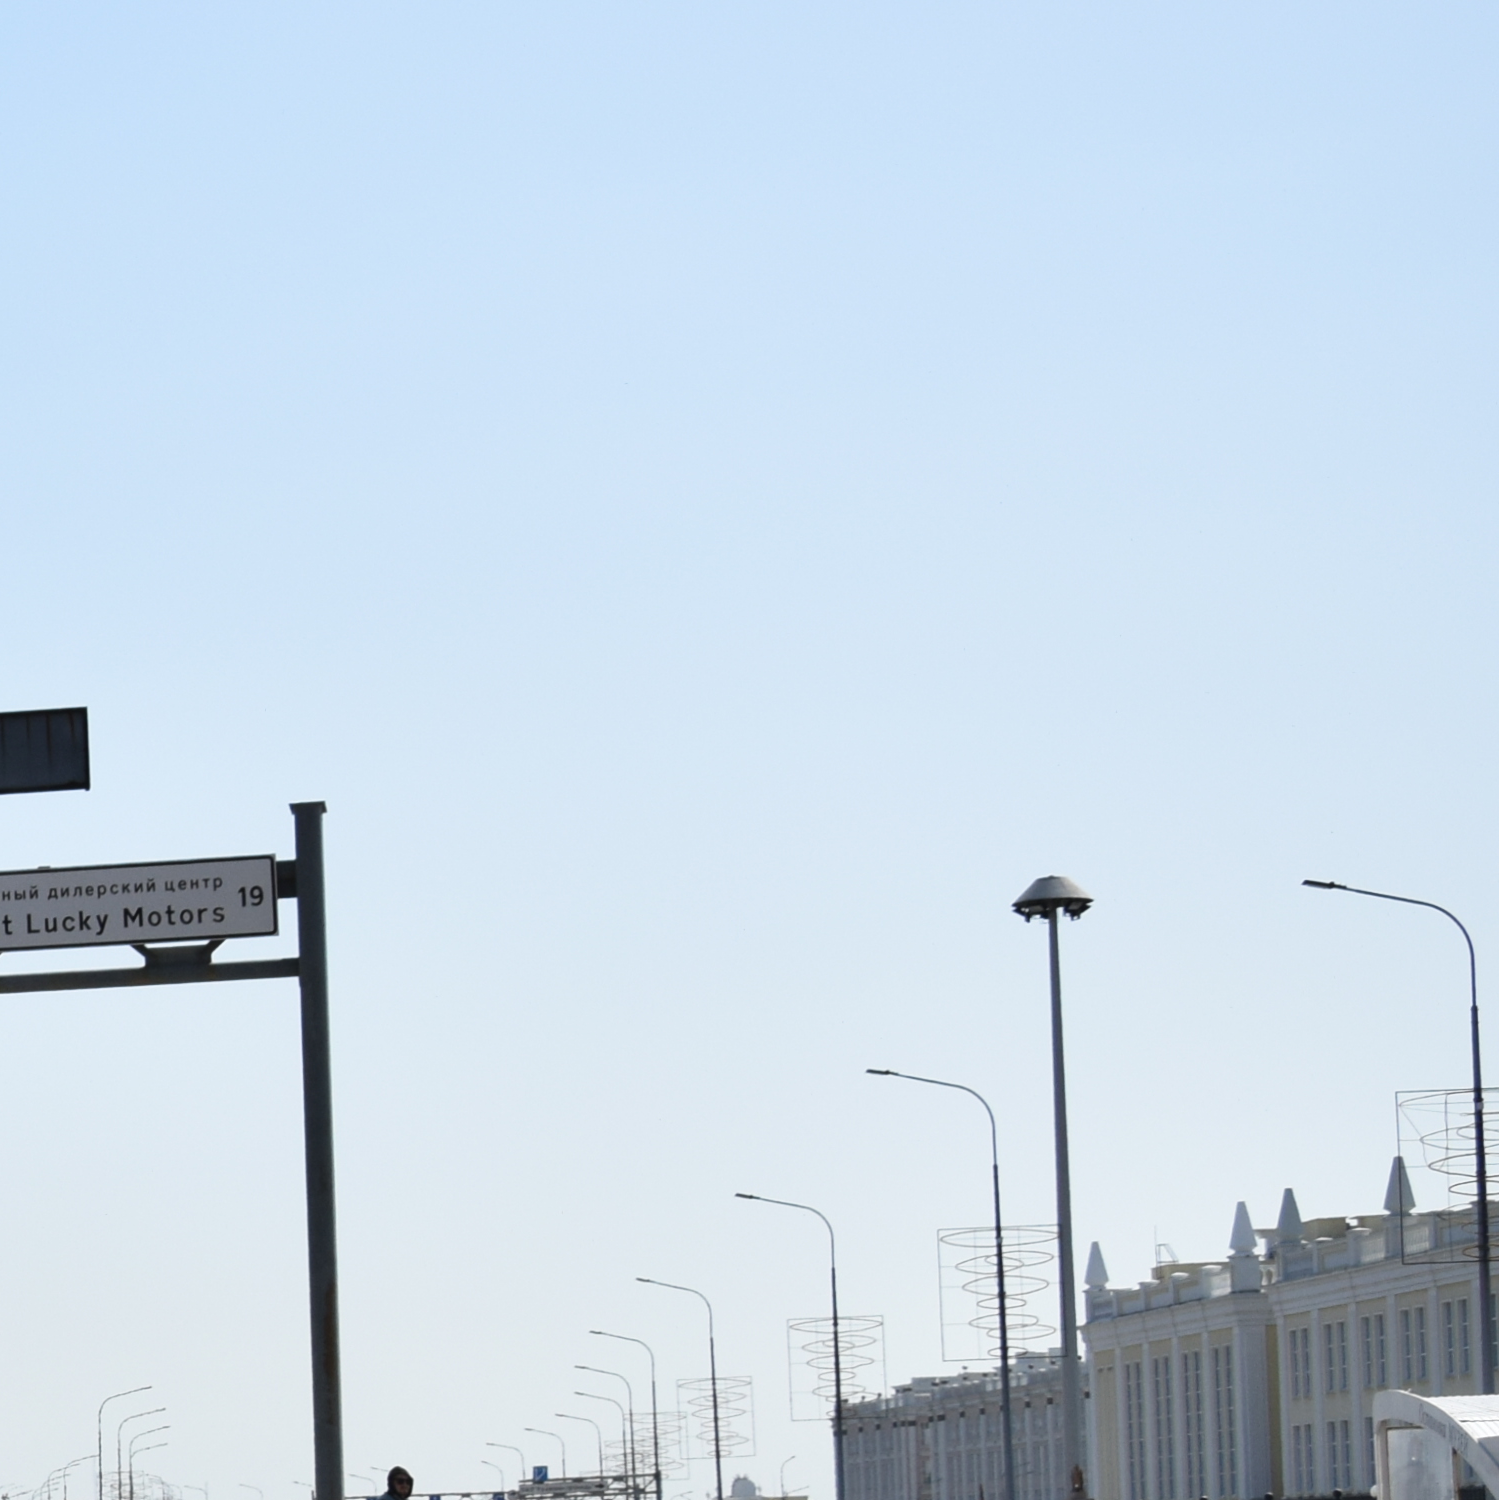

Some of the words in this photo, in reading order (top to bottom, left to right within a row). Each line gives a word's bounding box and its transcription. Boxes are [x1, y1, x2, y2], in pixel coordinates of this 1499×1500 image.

[47, 877, 156, 900] дилерский
[164, 876, 223, 893] центр
[237, 885, 265, 908] 19
[26, 909, 109, 937] Lucky
[122, 904, 226, 929] Motors
